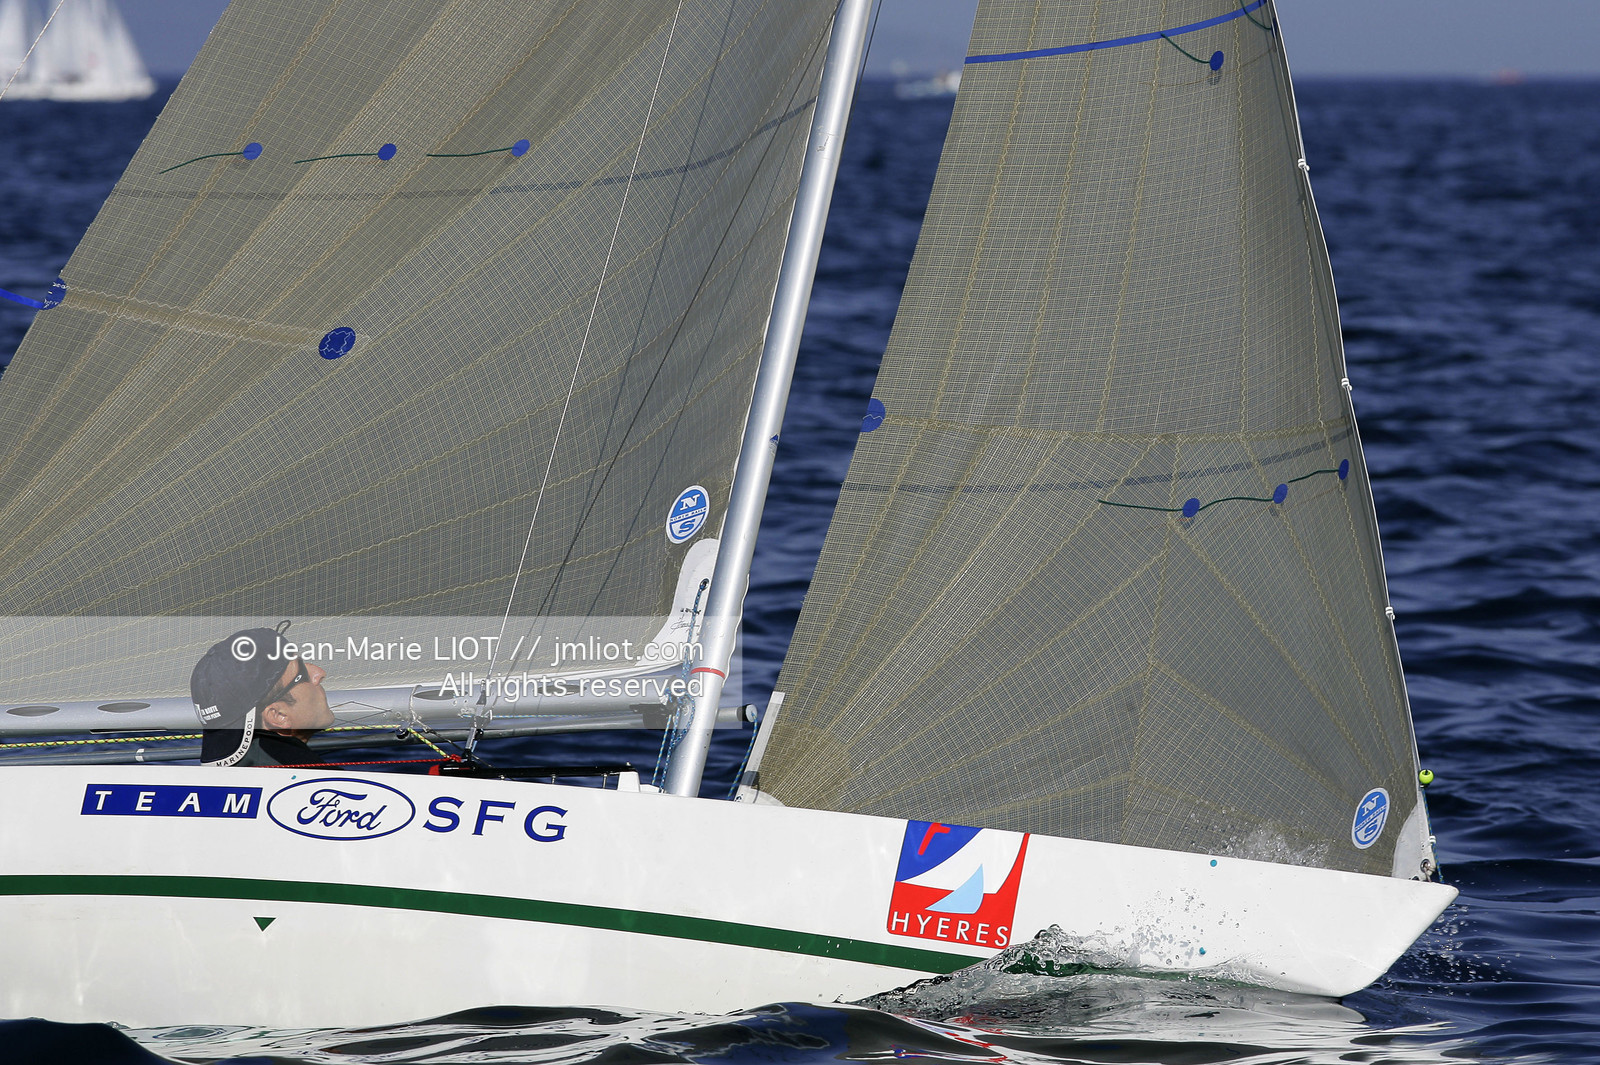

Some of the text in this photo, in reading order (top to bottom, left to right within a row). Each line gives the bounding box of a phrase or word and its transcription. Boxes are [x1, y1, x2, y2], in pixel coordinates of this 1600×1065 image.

[680, 493, 701, 511] N
[678, 519, 695, 534] S
[216, 718, 254, 767] MARINEPOOL
[94, 788, 568, 843] TEAM Ford SFG
[1361, 794, 1380, 817] N
[1363, 819, 1378, 839] S
[891, 911, 1009, 947] HYERES
